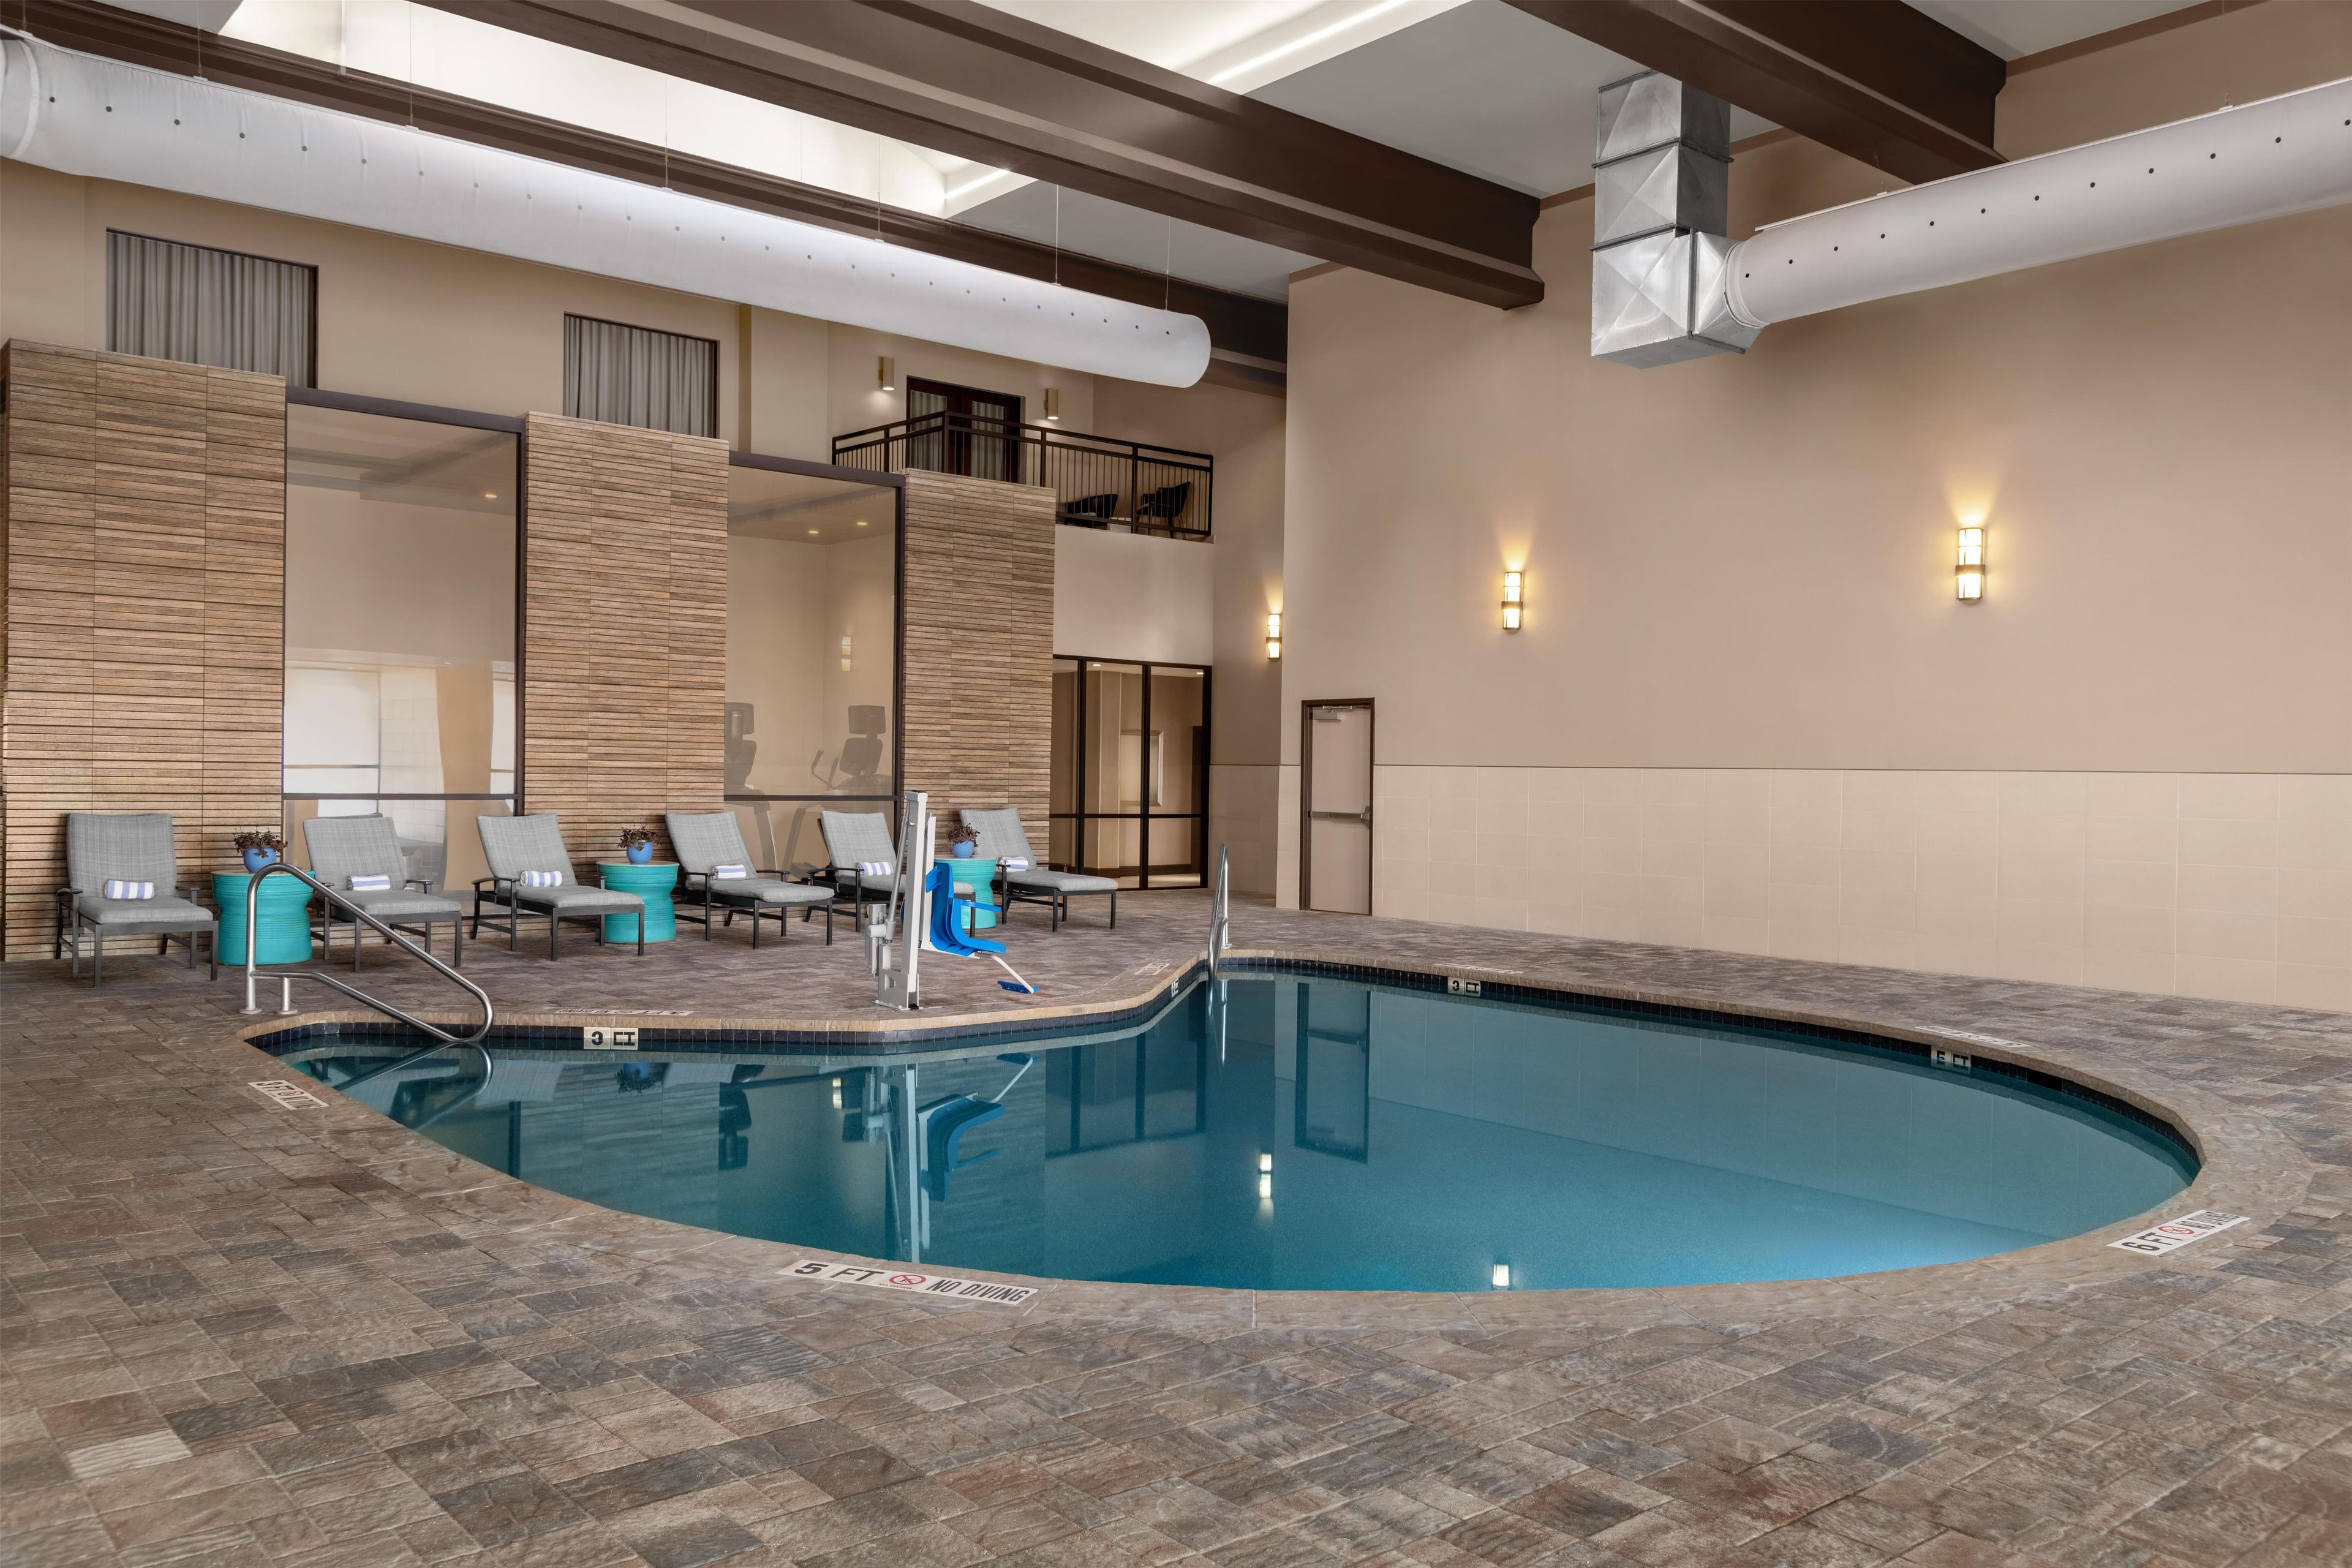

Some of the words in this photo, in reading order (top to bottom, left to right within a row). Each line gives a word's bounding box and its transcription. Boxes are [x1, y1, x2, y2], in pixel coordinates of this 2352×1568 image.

[2136, 1232, 2183, 1245] FT
[2121, 1242, 2160, 1251] 6
[794, 1262, 829, 1274] 5
[829, 1267, 885, 1281] FT
[925, 1280, 956, 1292] NO
[957, 1283, 1030, 1302] DIVING
